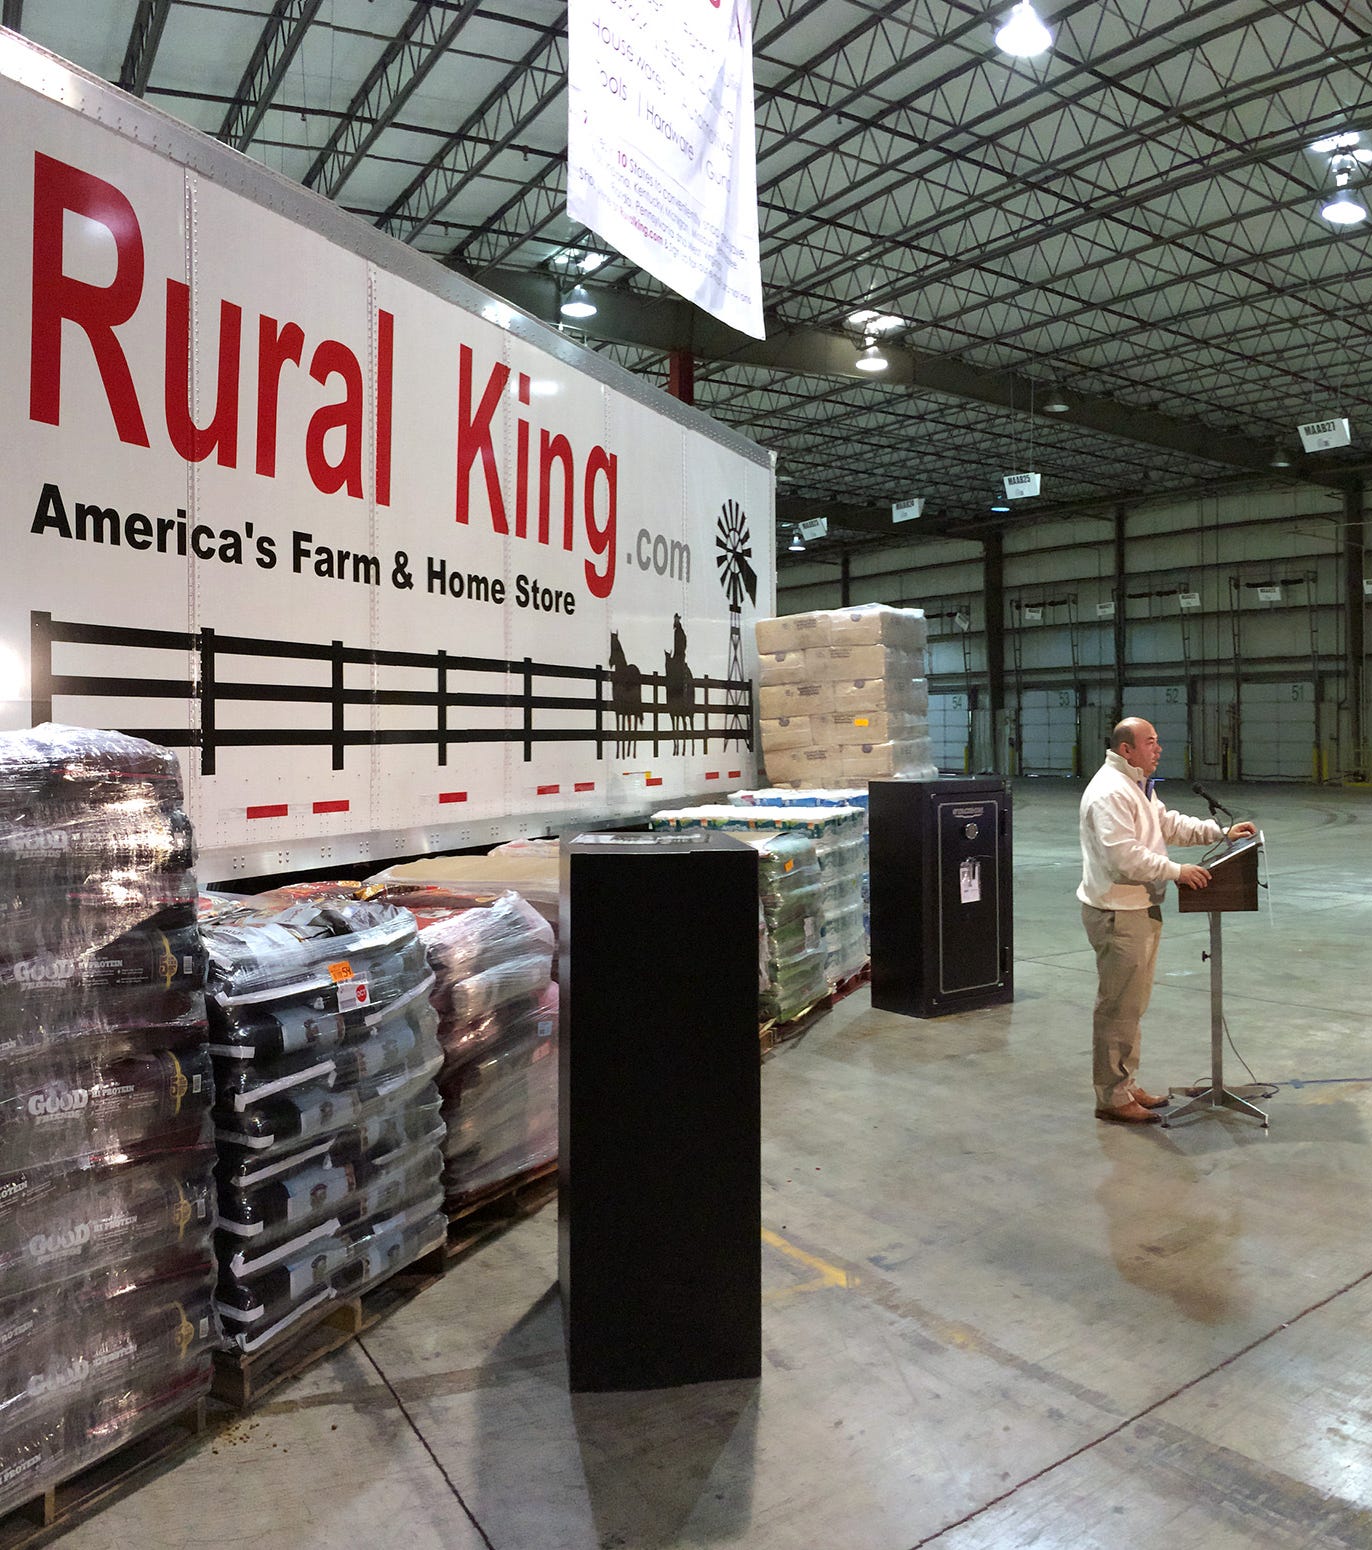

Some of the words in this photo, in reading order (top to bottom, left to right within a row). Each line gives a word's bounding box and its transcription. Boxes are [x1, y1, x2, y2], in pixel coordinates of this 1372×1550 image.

[617, 150, 628, 169] 10
[30, 150, 395, 507] Rural
[455, 343, 618, 599] King
[1303, 421, 1336, 436] MAAB27
[30, 483, 277, 569] America's
[292, 530, 381, 586] Farm
[391, 550, 414, 590] &
[427, 556, 506, 605] Home
[515, 574, 576, 616] Store
[1166, 688, 1179, 703] 52
[13, 959, 74, 982] GOOD
[28, 1088, 89, 1116] GOOD
